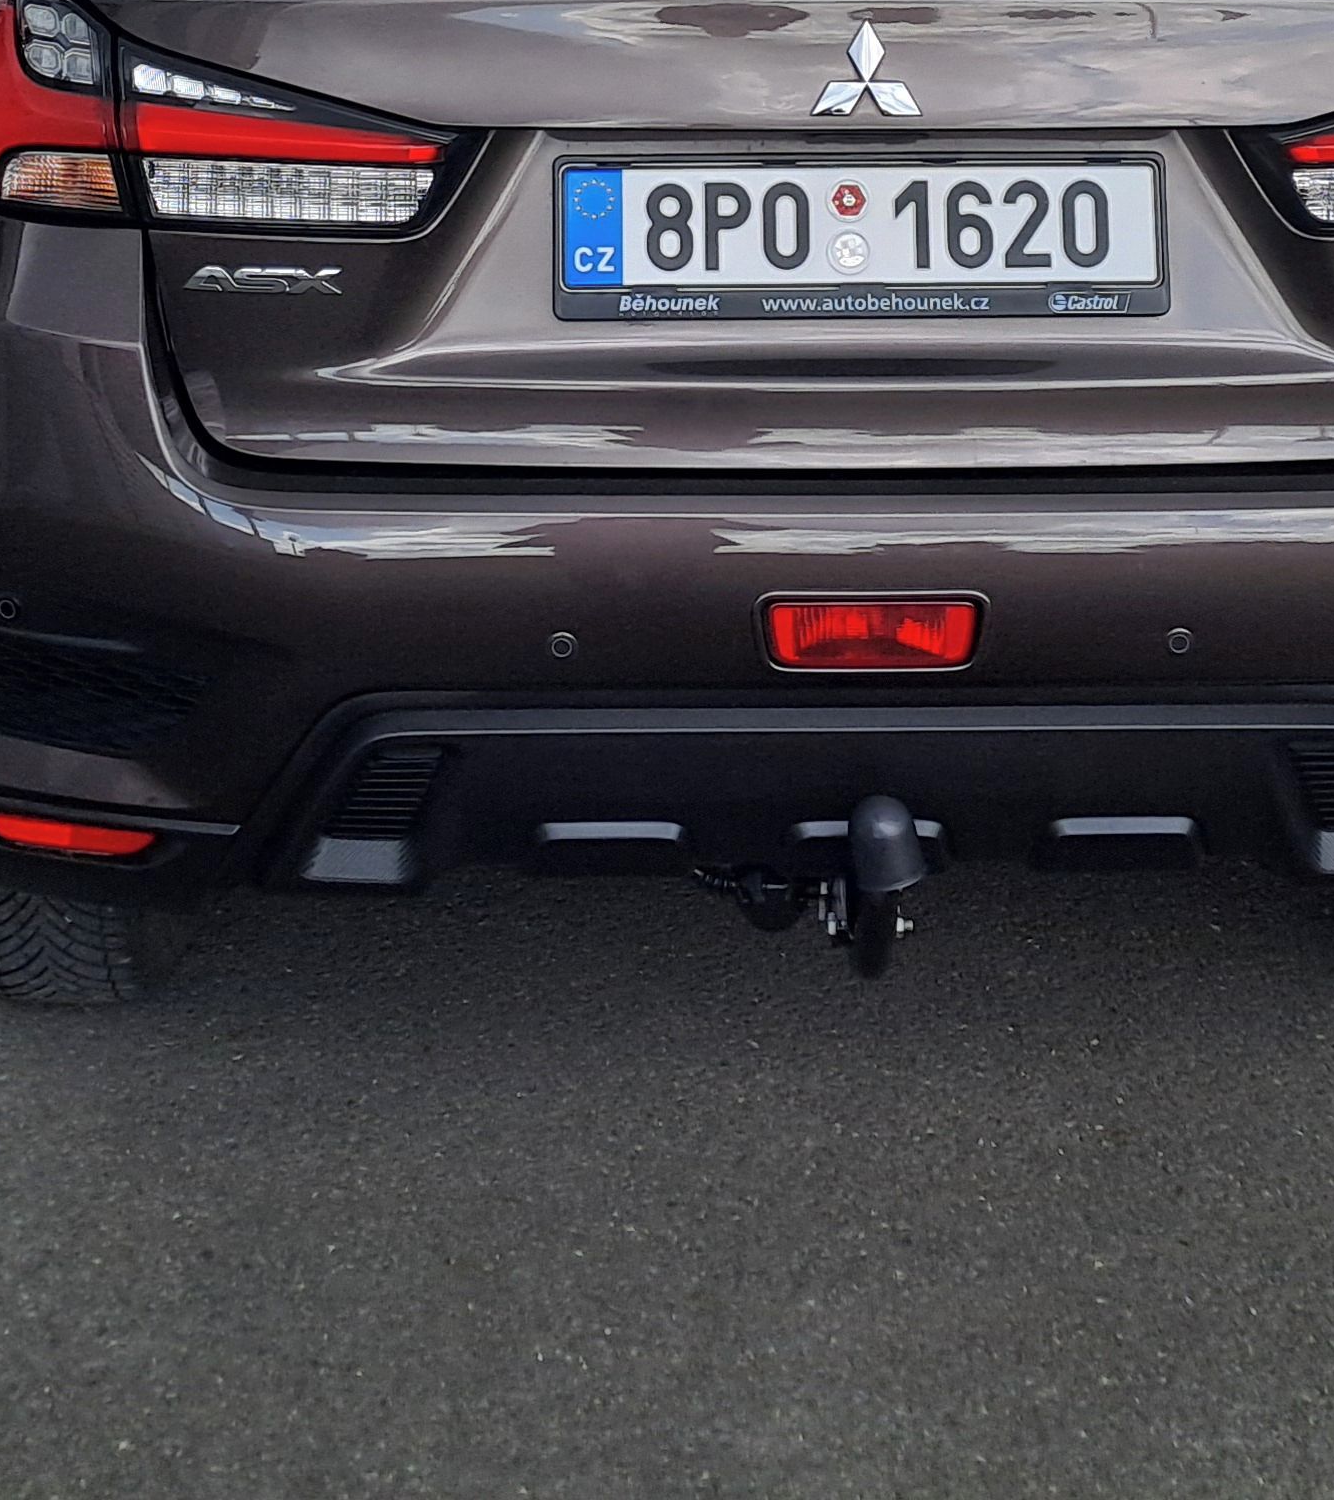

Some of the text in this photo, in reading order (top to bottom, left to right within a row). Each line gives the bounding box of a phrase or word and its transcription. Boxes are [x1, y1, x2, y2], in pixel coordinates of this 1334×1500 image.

[646, 179, 1109, 271] 8P0 1620
[573, 246, 616, 273] CZ
[183, 265, 343, 295] ASX
[619, 293, 721, 312] Běhounek
[762, 293, 990, 312] www.autobehounek.cz
[1067, 294, 1119, 311] Castrol
